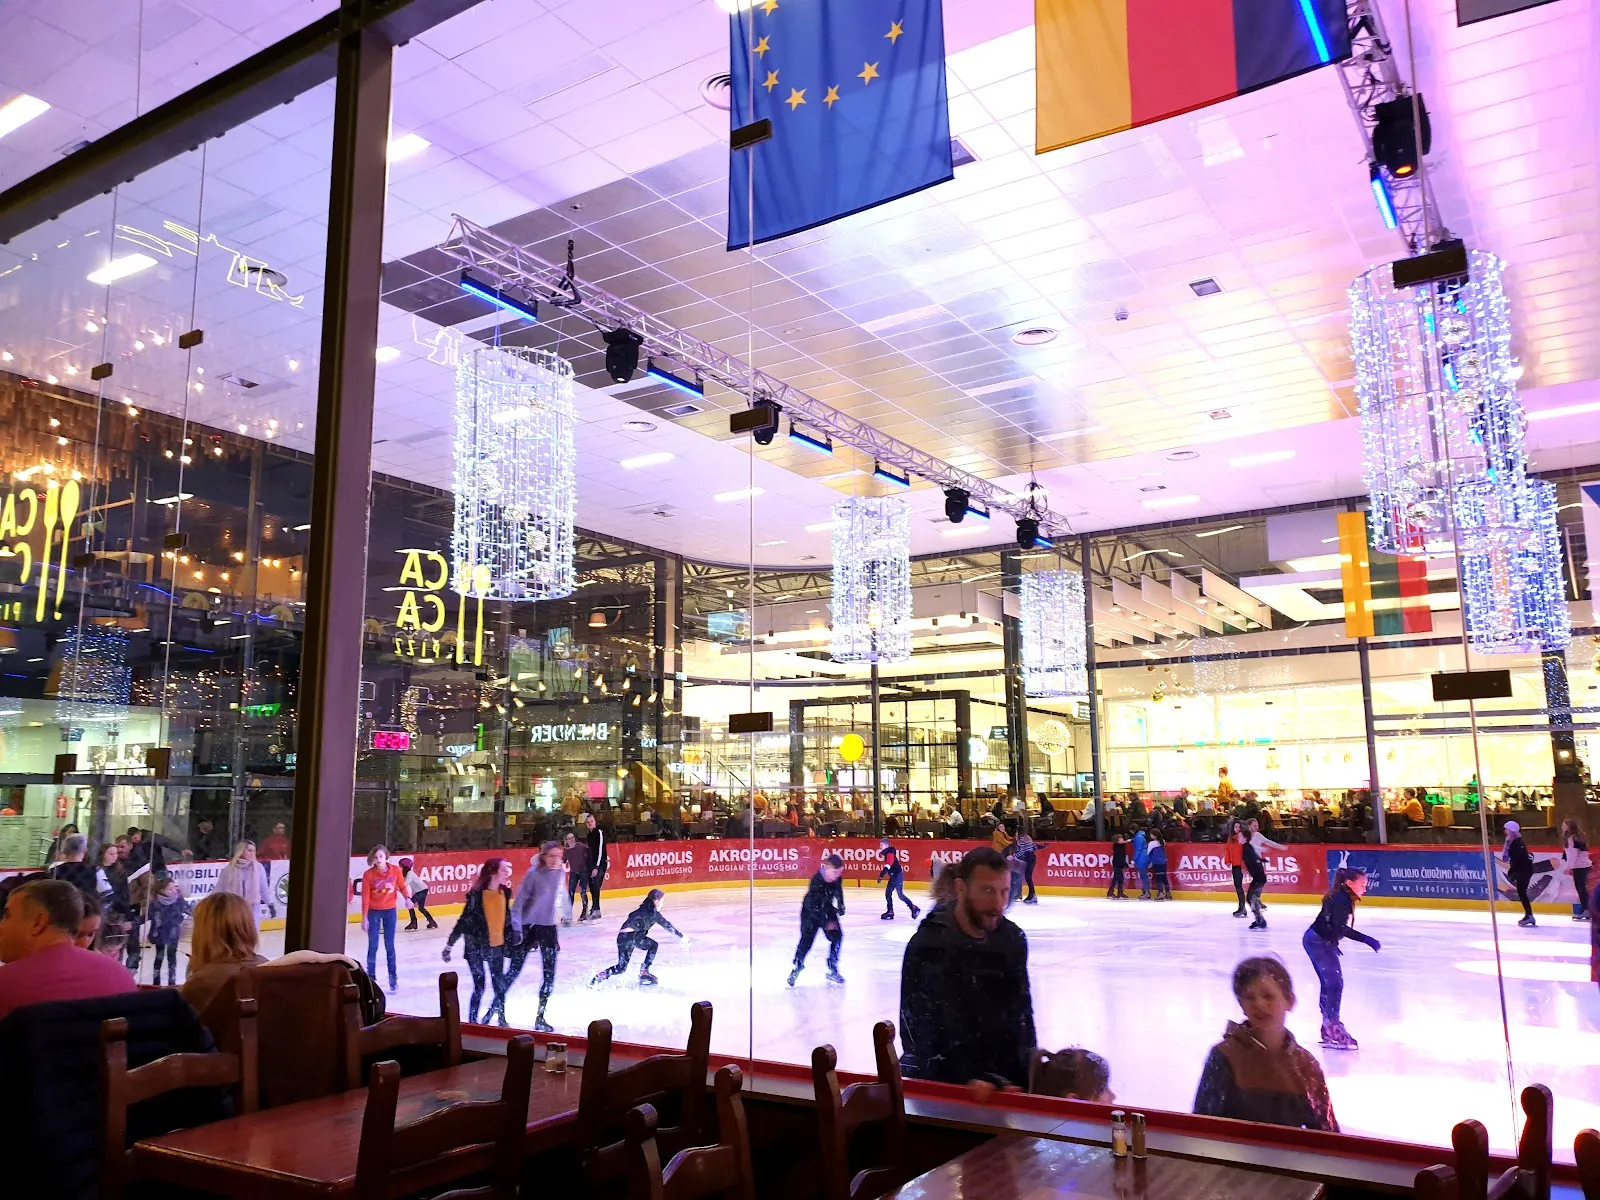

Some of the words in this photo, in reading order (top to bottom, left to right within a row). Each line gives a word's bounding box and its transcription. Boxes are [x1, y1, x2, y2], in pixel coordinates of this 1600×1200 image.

[626, 850, 693, 868] AKROPOLIS
[709, 848, 799, 863] AKROPOLIS
[820, 847, 910, 863] AKROPOIS
[1047, 852, 1153, 869] AKROP
[420, 861, 513, 882] AKROPS
[708, 863, 744, 873] DAUGIAU
[1179, 855, 1299, 873] AKRLIS
[626, 869, 655, 879] DAUGIAU
[656, 866, 693, 877] DŽIAUGSMO
[1047, 869, 1090, 879] DAUGIAU
[1180, 872, 1227, 882] DAUGIAU
[1390, 867, 1420, 878] DAILIOJO
[1420, 866, 1453, 880] ČIUOŽIMO
[1453, 869, 1487, 881] MOKYKLA
